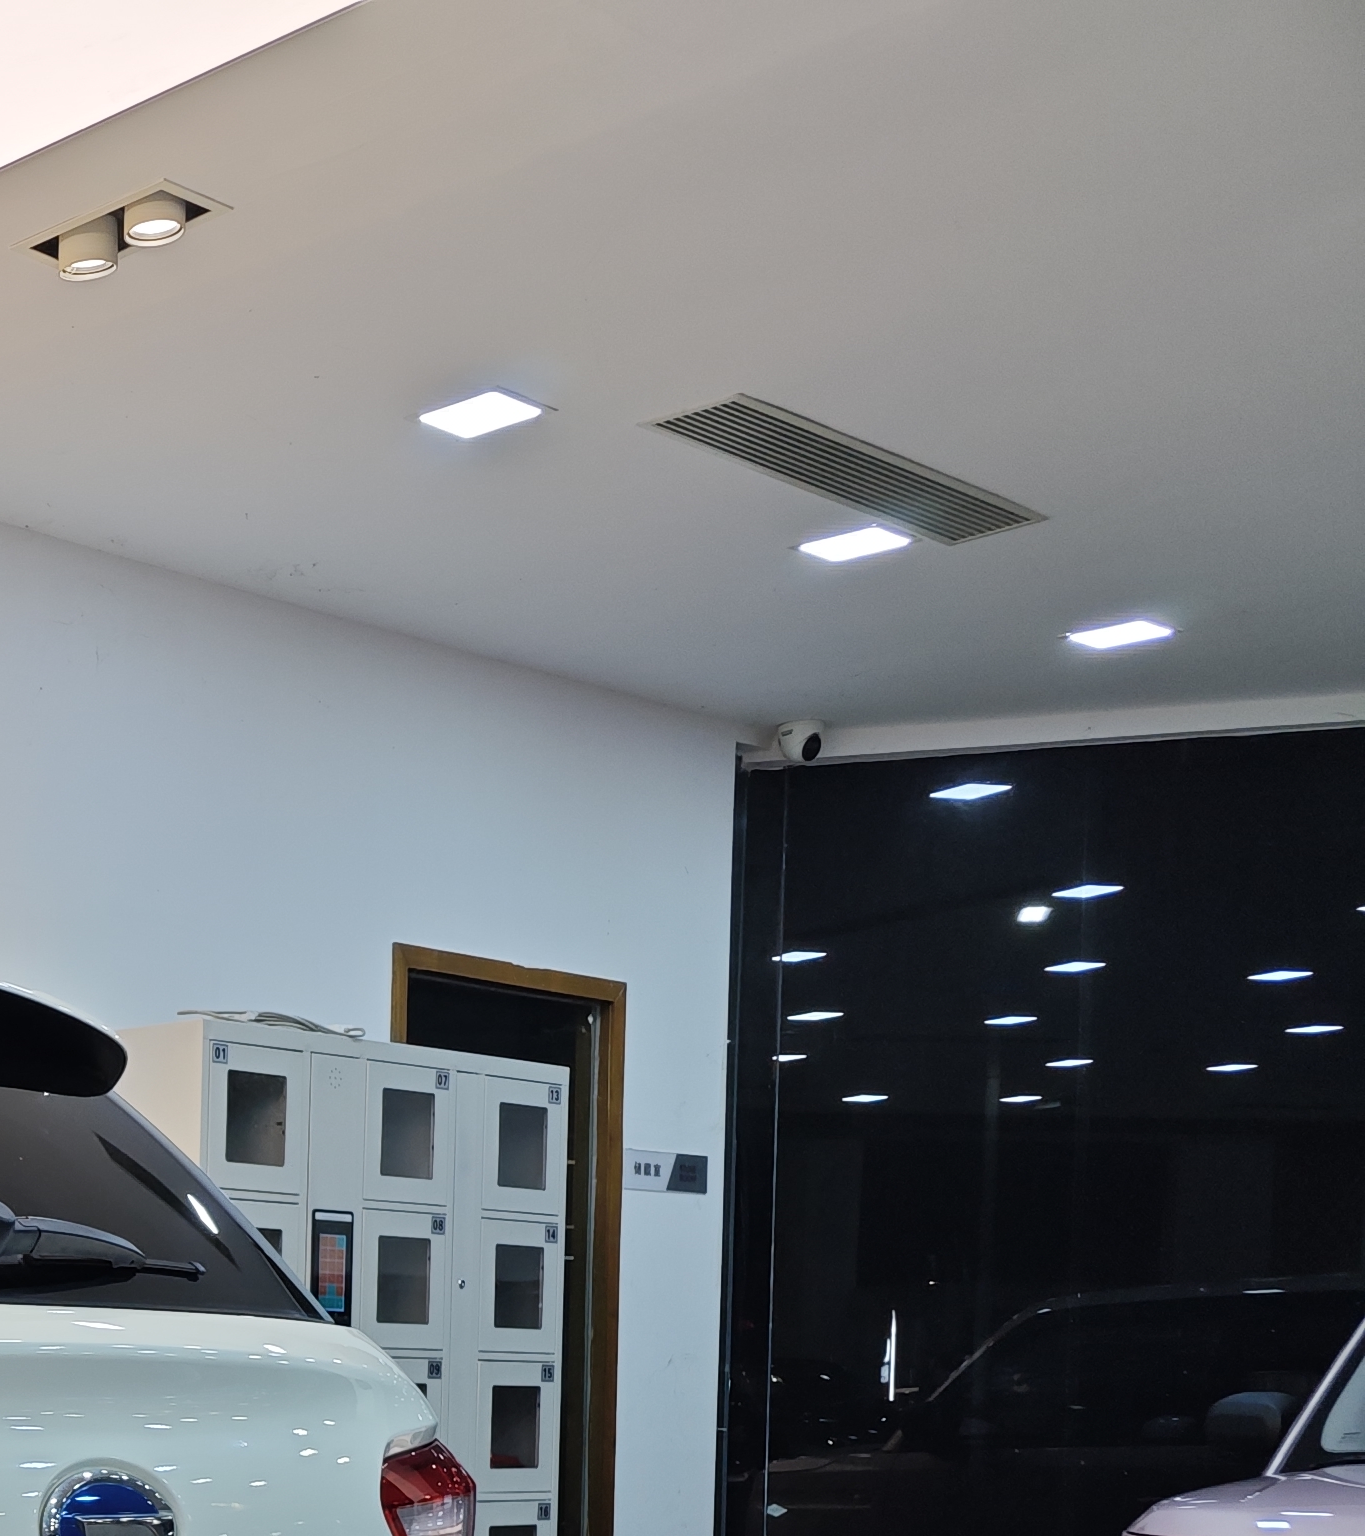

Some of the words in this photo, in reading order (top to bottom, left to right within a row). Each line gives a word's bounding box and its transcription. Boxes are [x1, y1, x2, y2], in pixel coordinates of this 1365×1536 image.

[214, 1047, 226, 1060] 01
[437, 1073, 448, 1086] 07
[550, 1089, 560, 1101] 13
[432, 1219, 444, 1231] 08
[546, 1229, 556, 1240] 14
[429, 1363, 441, 1376] 09
[543, 1367, 552, 1379] 15
[539, 1506, 549, 1517] 16
